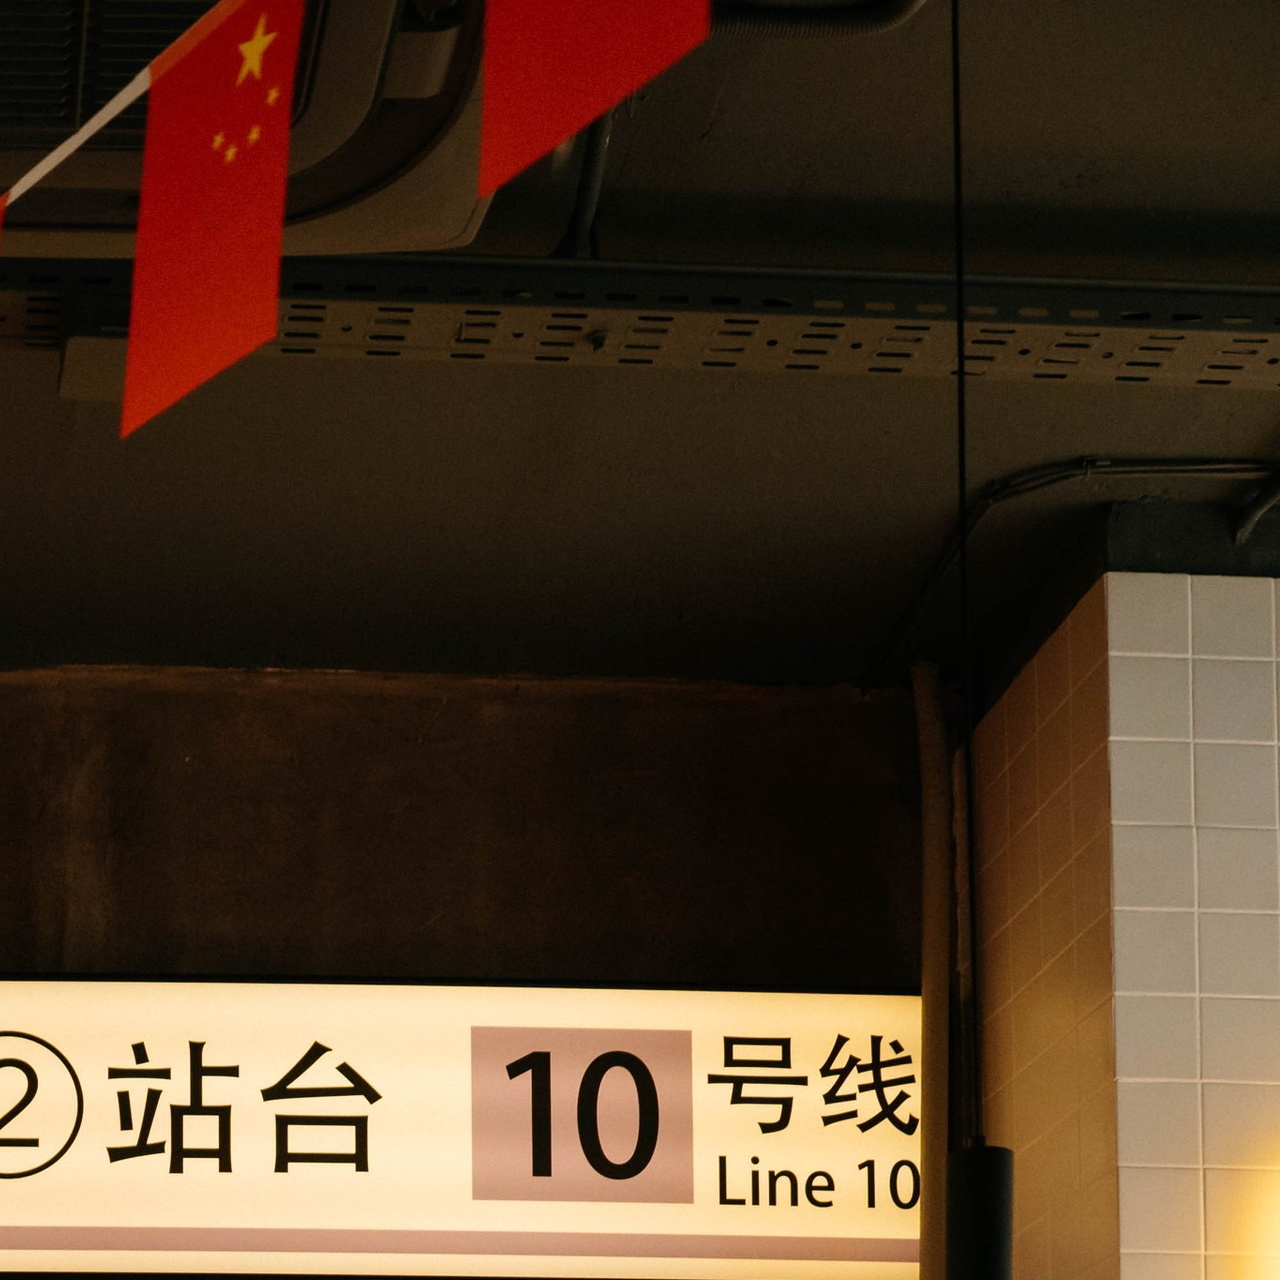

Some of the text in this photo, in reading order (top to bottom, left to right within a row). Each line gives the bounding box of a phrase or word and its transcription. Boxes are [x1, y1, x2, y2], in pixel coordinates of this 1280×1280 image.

[106, 1040, 383, 1175] 站台
[505, 1050, 661, 1181] 10
[707, 1033, 920, 1137] 号线
[718, 1155, 920, 1210] Line 10
